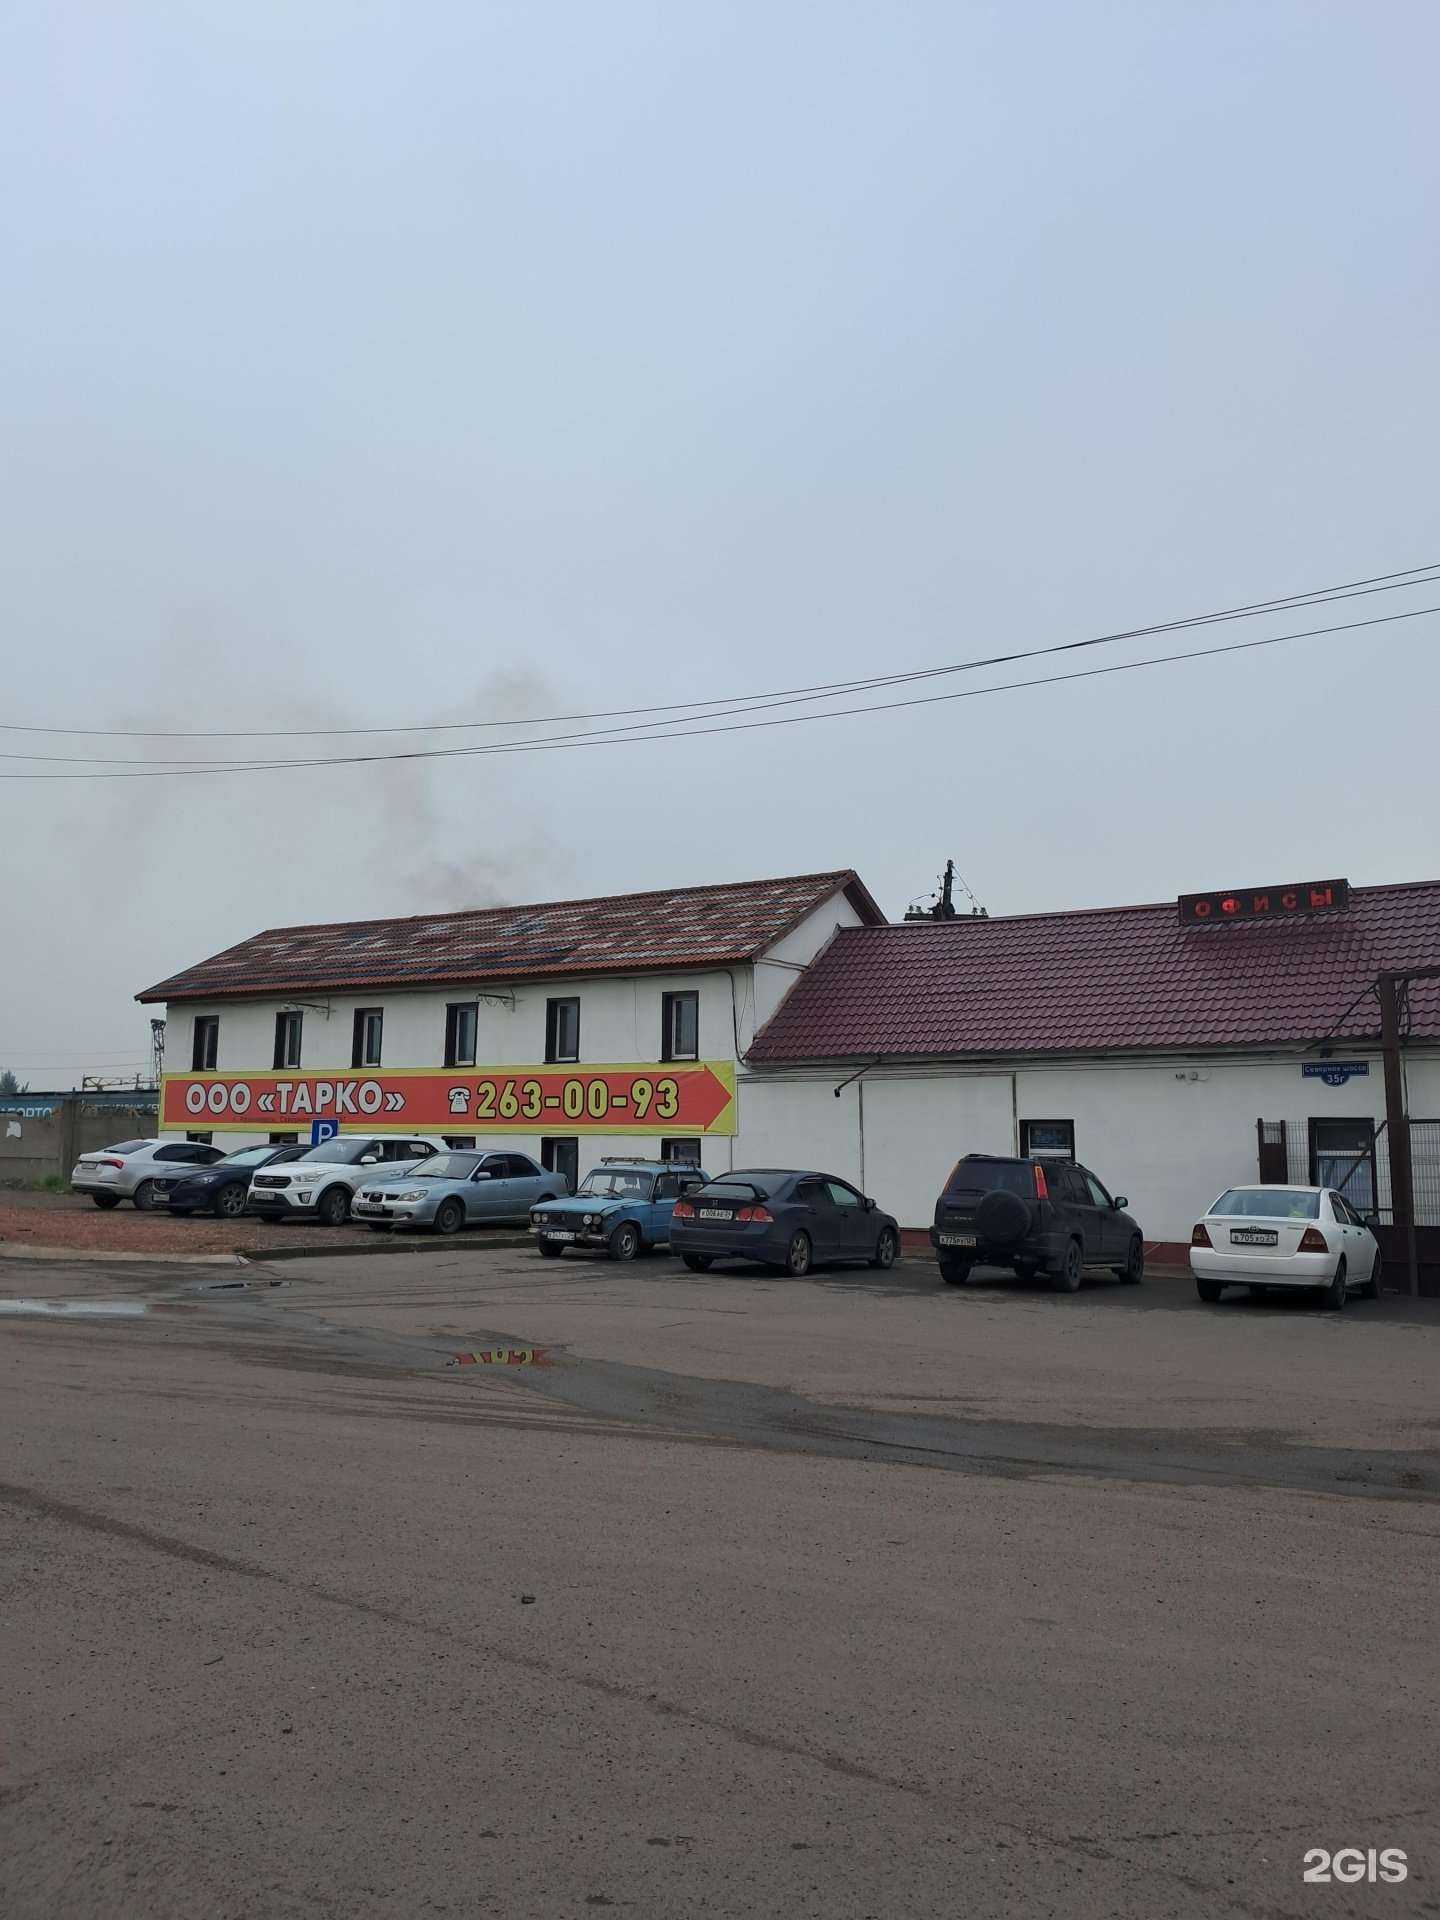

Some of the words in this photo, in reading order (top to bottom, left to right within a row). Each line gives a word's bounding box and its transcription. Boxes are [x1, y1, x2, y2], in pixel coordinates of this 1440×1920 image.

[1194, 886, 1333, 917] ОФИСЫ
[185, 1082, 252, 1115] ООО
[257, 1079, 406, 1115] «ТАРКО»
[475, 1077, 680, 1119] 263-00-93
